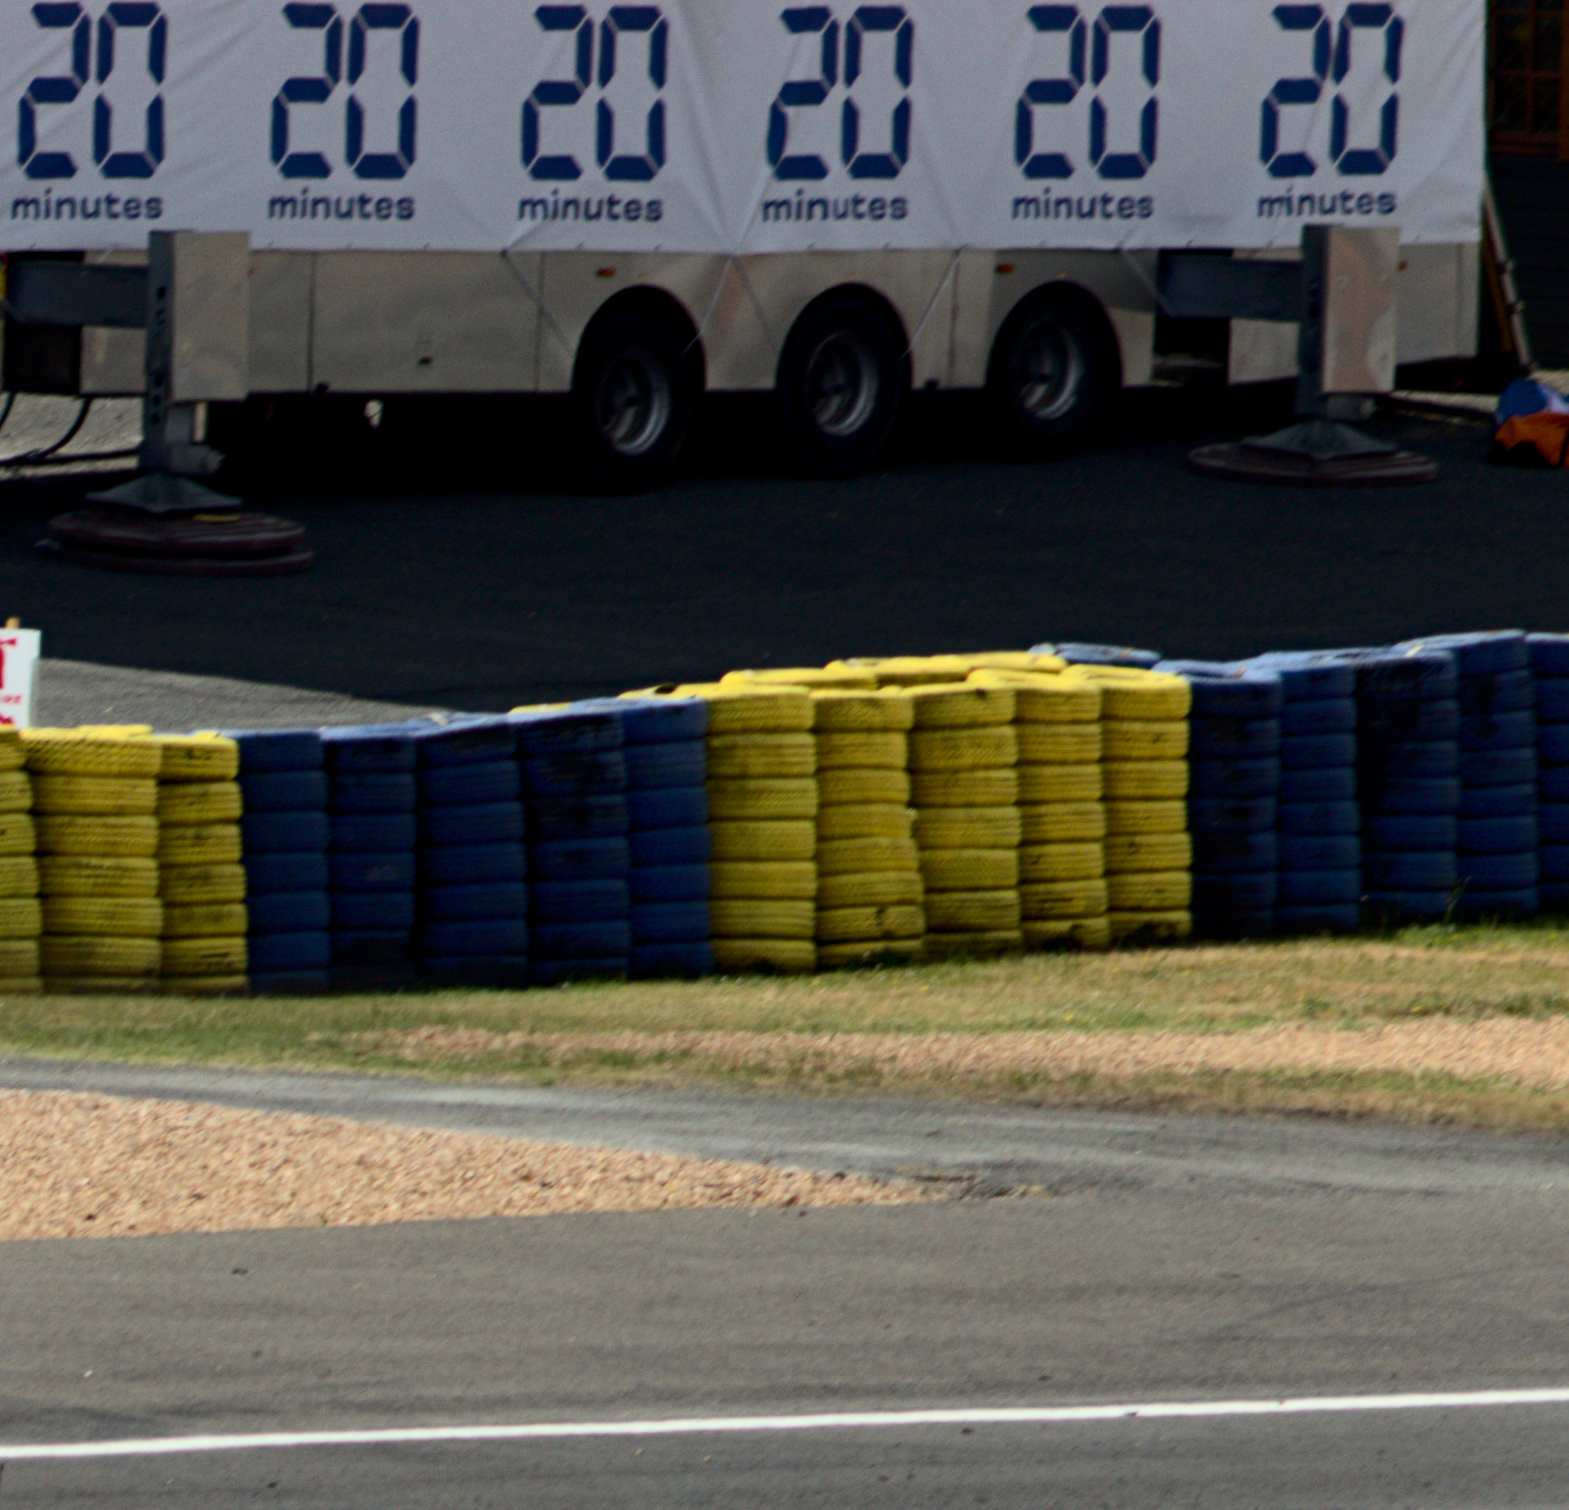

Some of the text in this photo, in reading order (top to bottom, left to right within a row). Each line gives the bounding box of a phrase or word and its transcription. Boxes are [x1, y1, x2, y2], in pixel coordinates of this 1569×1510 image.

[17, 2, 167, 180] 20
[270, 2, 419, 180] 20
[520, 5, 668, 182] 20
[766, 6, 914, 181] 20
[1014, 5, 1161, 180] 20
[1259, 3, 1404, 179] 20
[10, 186, 164, 222] minutes
[266, 186, 416, 222] minutes
[517, 187, 664, 223] minutes
[762, 188, 909, 222] minutes
[1011, 187, 1155, 222] minutes
[1256, 186, 1398, 220] minutes
